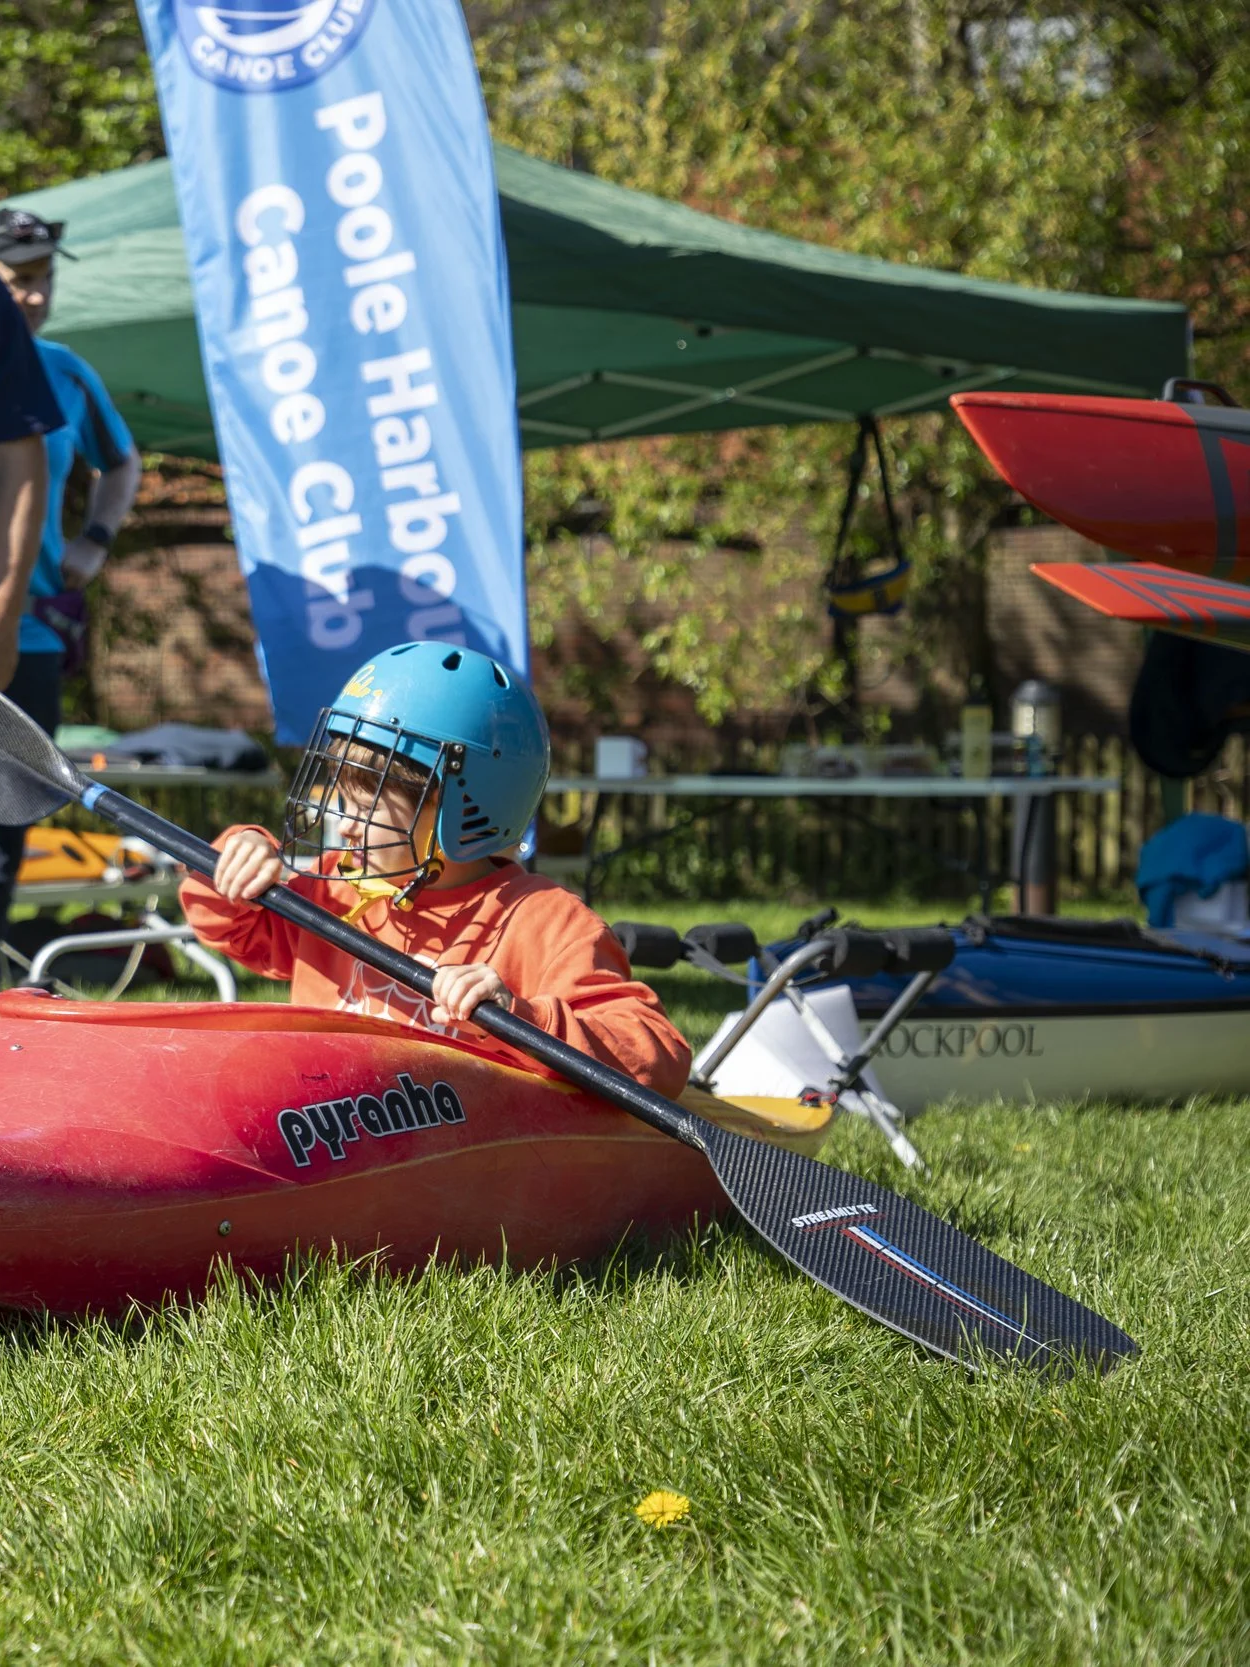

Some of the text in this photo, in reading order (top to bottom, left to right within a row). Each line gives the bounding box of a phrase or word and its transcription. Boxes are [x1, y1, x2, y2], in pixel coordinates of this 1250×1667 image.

[192, 35, 296, 82] CANOE
[315, 91, 417, 335] Poole
[235, 183, 327, 446] Canoe
[288, 460, 375, 650] Club
[361, 347, 467, 648] Harbou
[277, 1072, 467, 1168] pyranha
